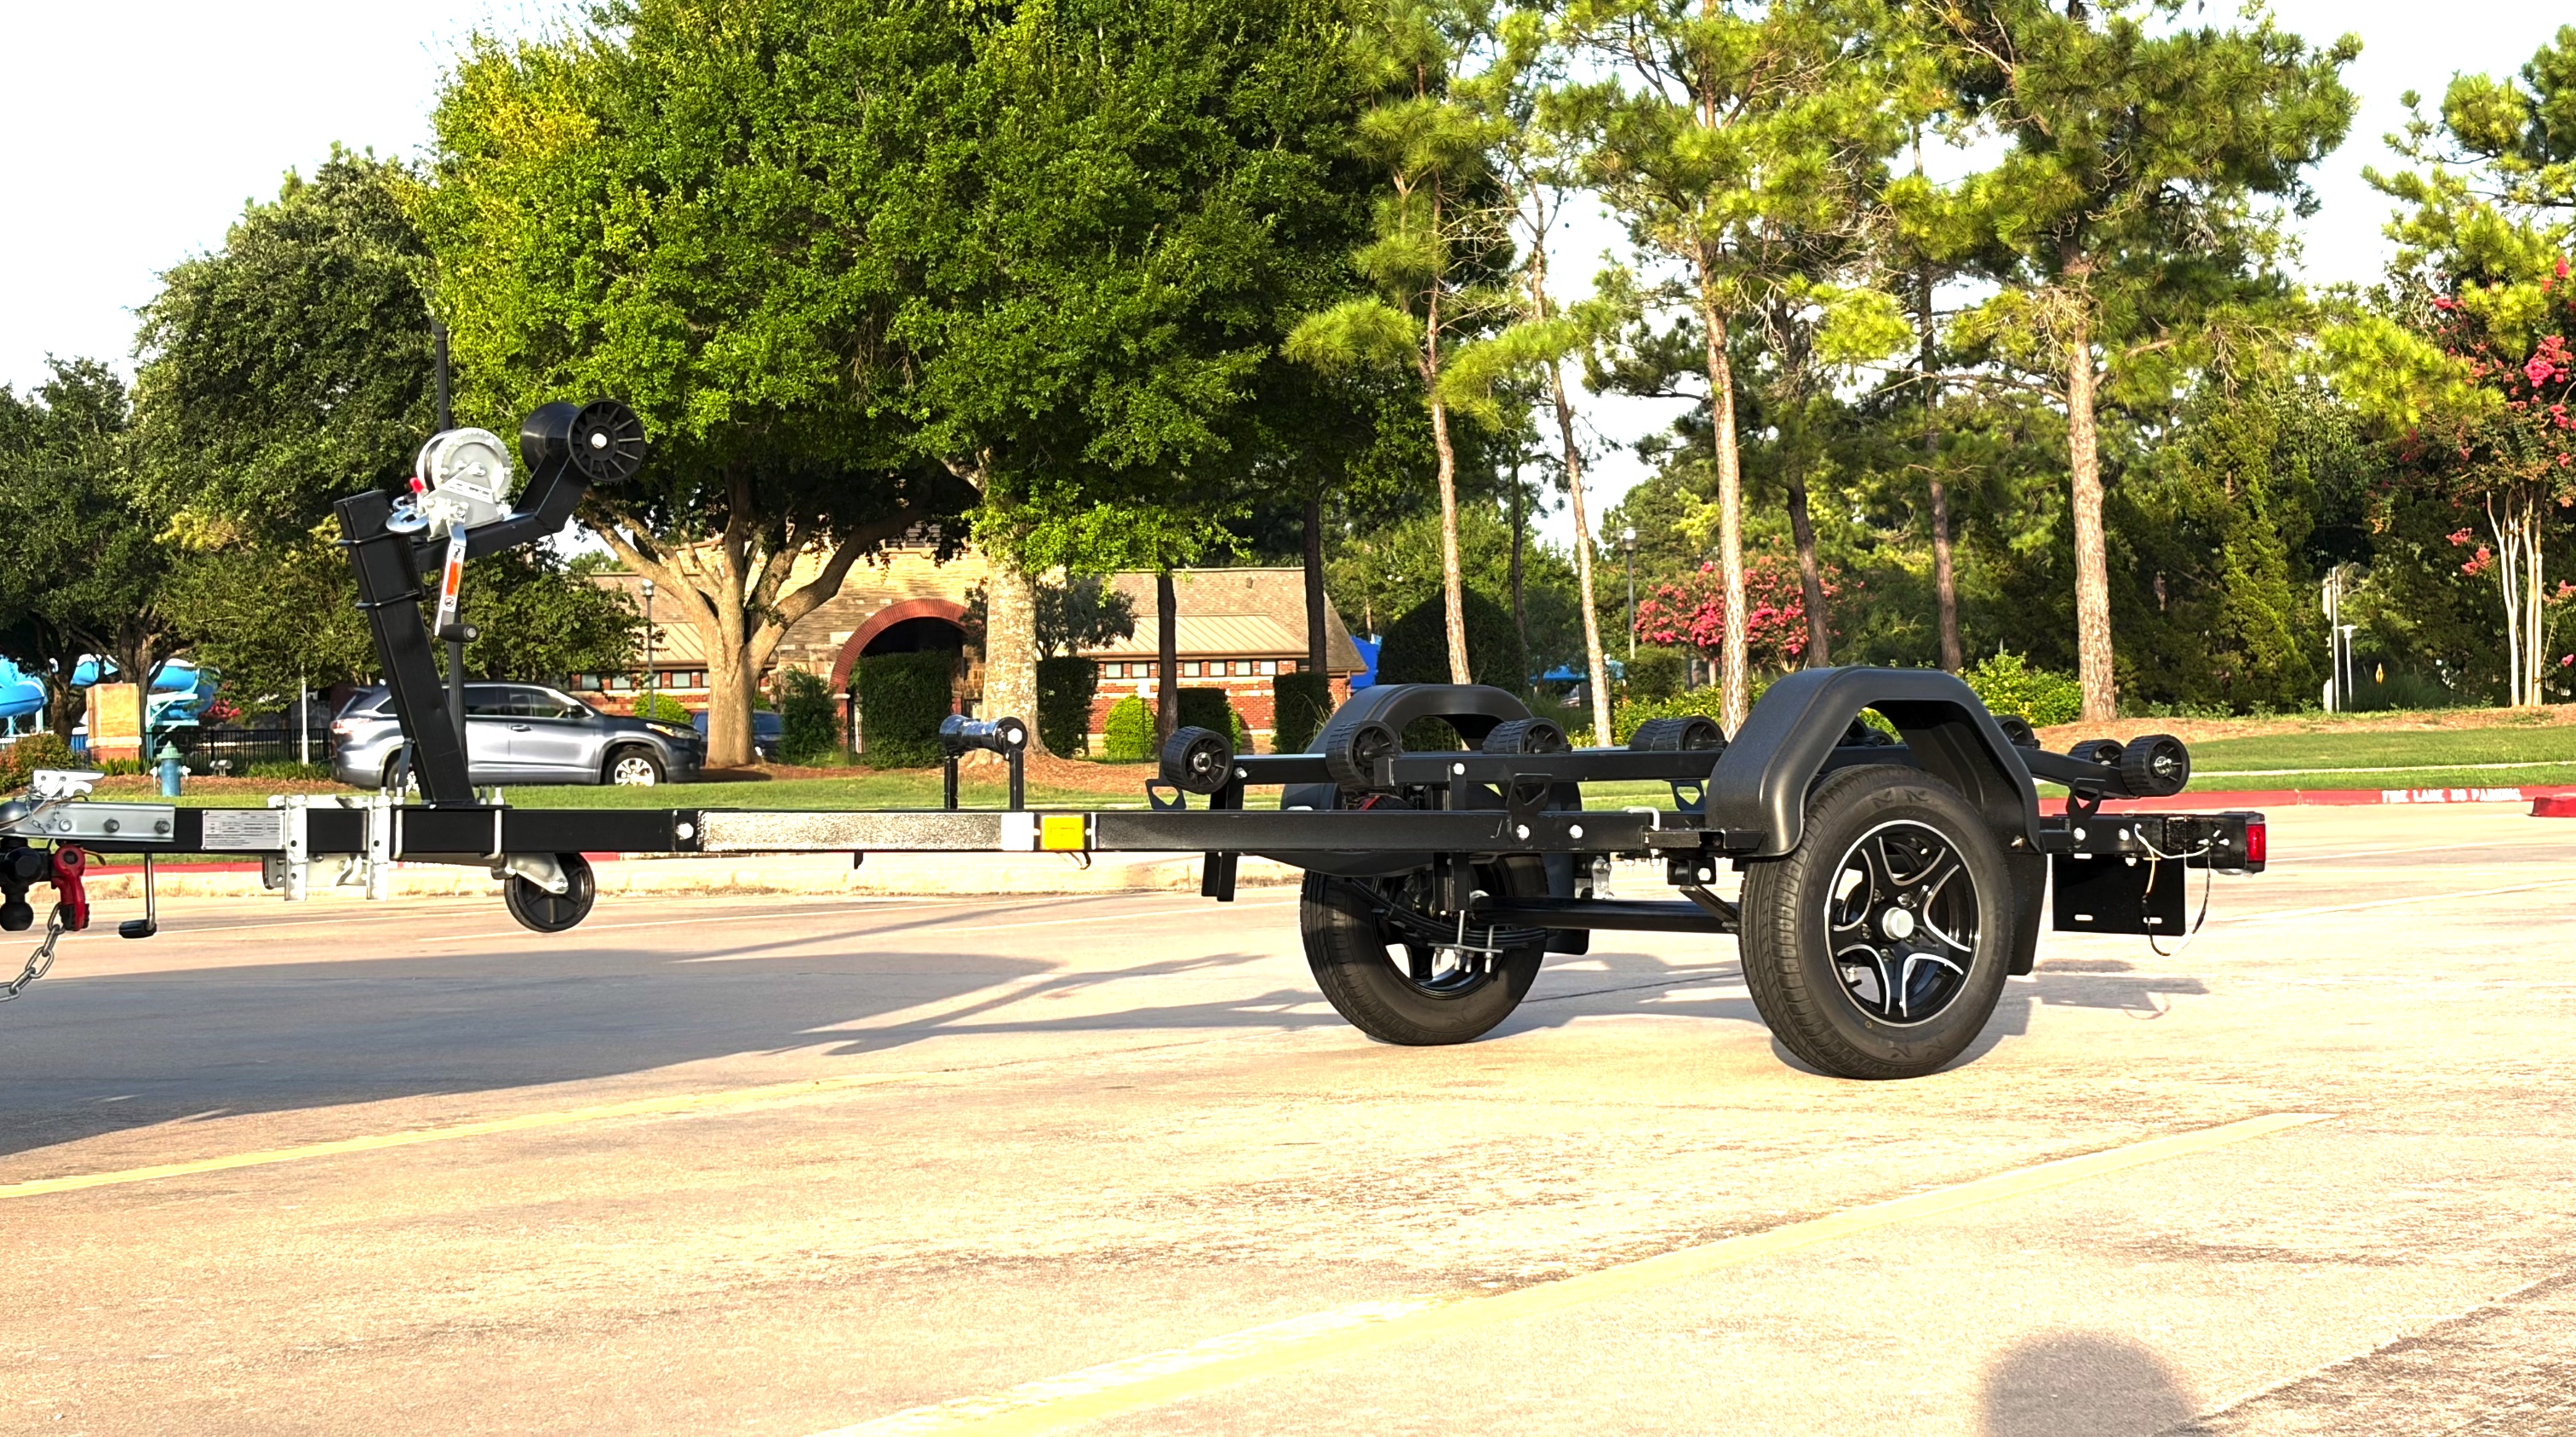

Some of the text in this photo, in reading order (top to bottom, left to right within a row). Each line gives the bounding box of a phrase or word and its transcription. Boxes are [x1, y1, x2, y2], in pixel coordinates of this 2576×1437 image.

[2413, 789, 2445, 802] LANE
[2450, 789, 2467, 801] NO
[2471, 788, 2522, 801] PARKING
